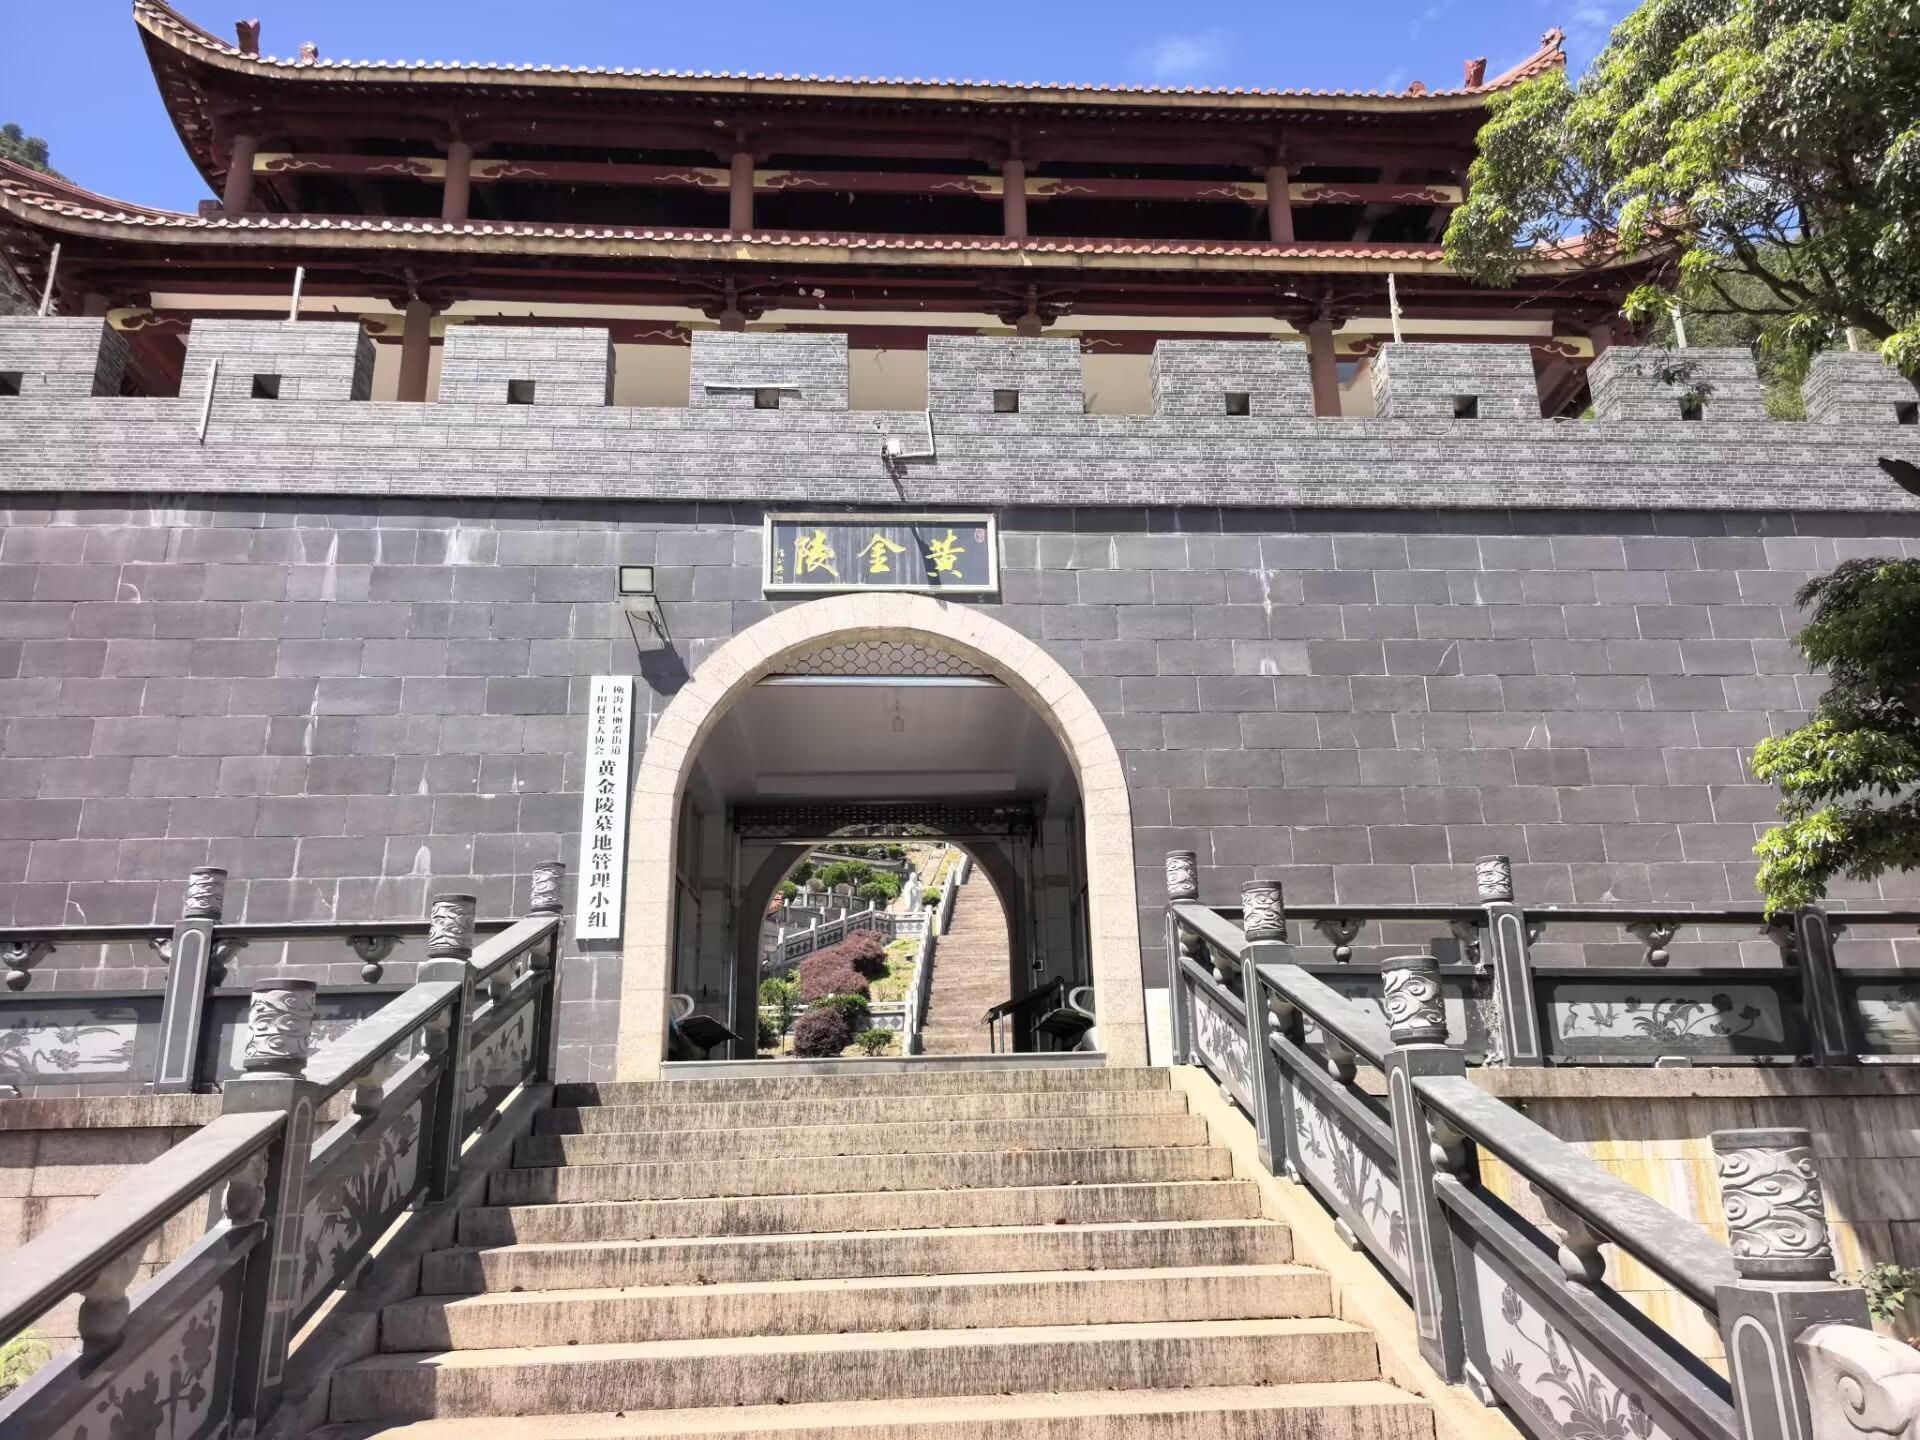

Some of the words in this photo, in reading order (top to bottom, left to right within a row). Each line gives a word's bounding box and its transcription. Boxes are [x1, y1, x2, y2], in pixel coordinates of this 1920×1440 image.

[794, 528, 966, 578] 黄金陵
[588, 759, 616, 928] 黄金陵墓地管理小组
